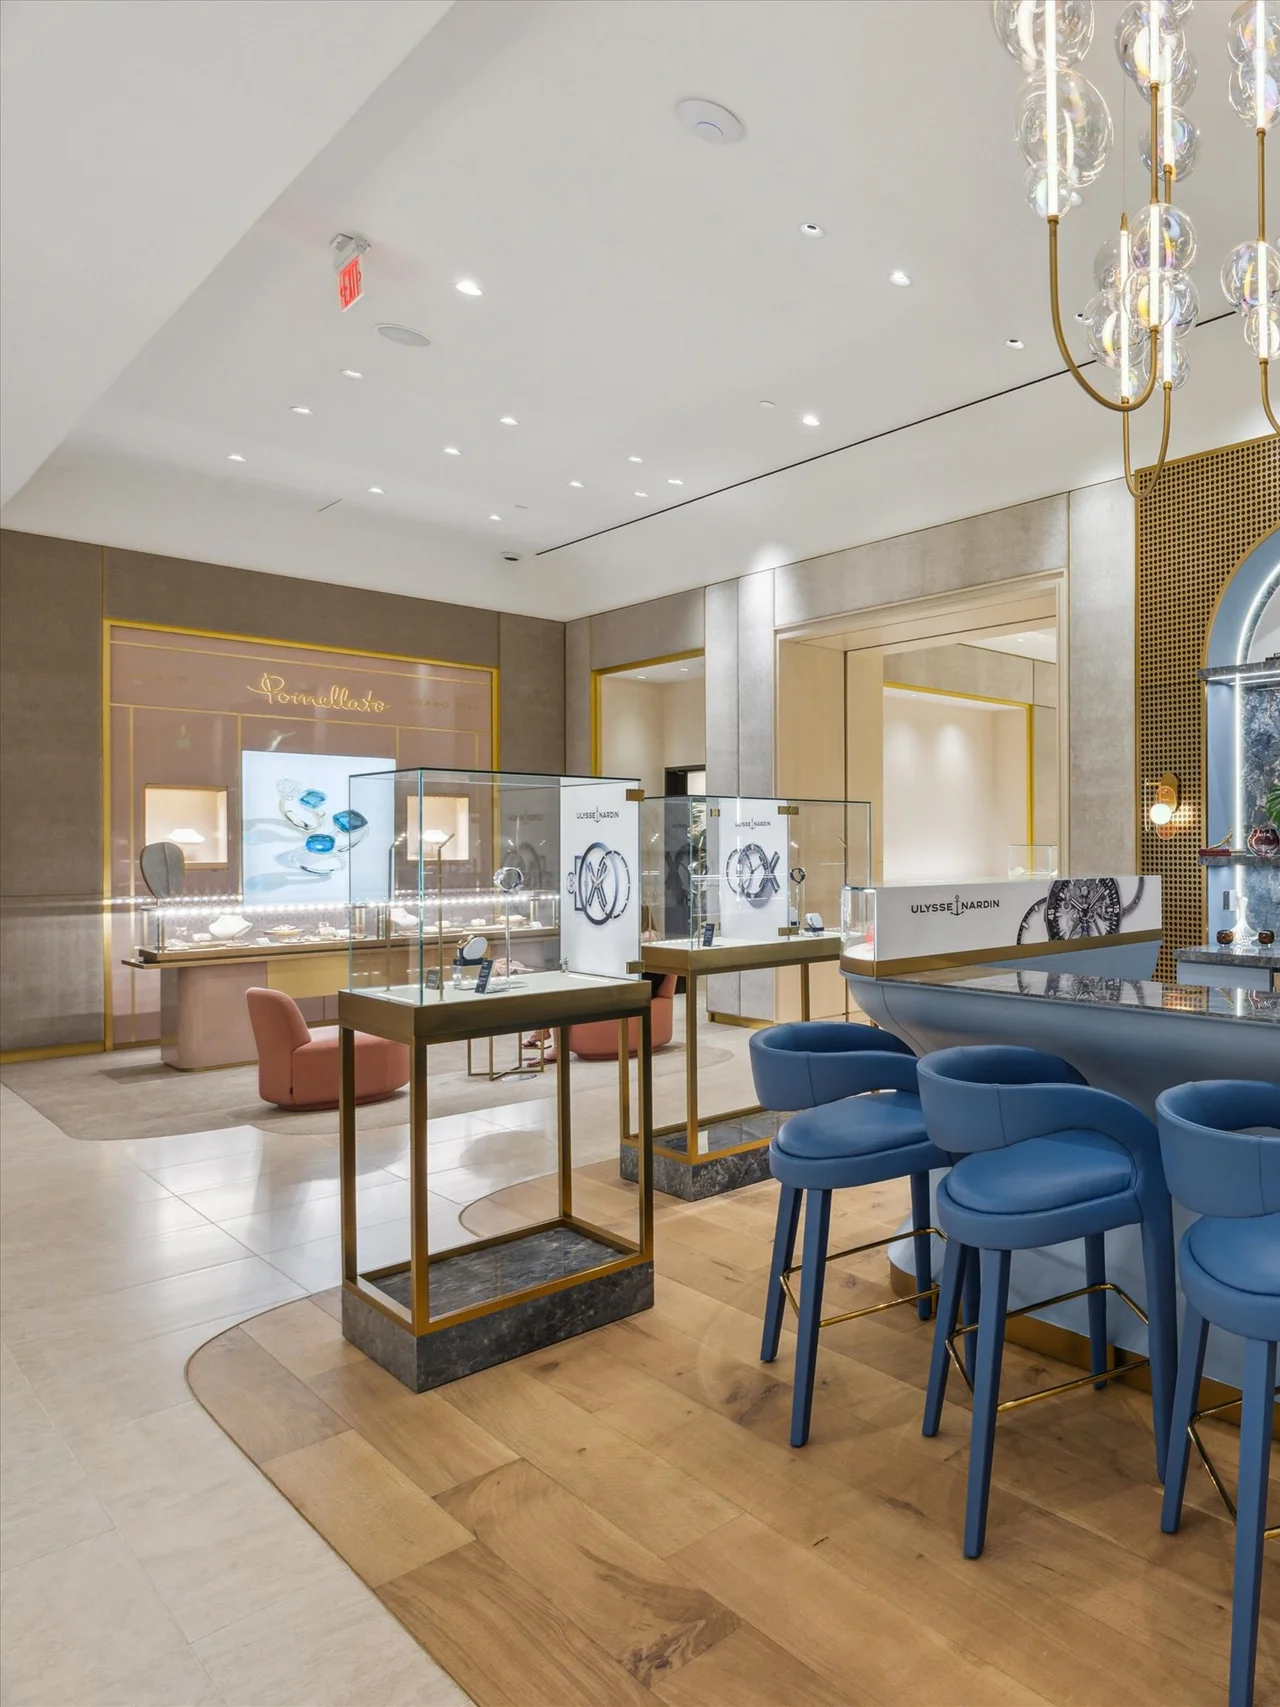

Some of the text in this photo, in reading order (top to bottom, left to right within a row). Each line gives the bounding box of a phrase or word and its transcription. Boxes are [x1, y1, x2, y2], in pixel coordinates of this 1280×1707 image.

[342, 259, 360, 307] EXIT
[246, 672, 392, 713] Pomellato
[576, 811, 620, 820] ULYSSE NARDIN
[911, 899, 1000, 914] ULYSSE NARDIN
[1047, 908, 1055, 920] 45
